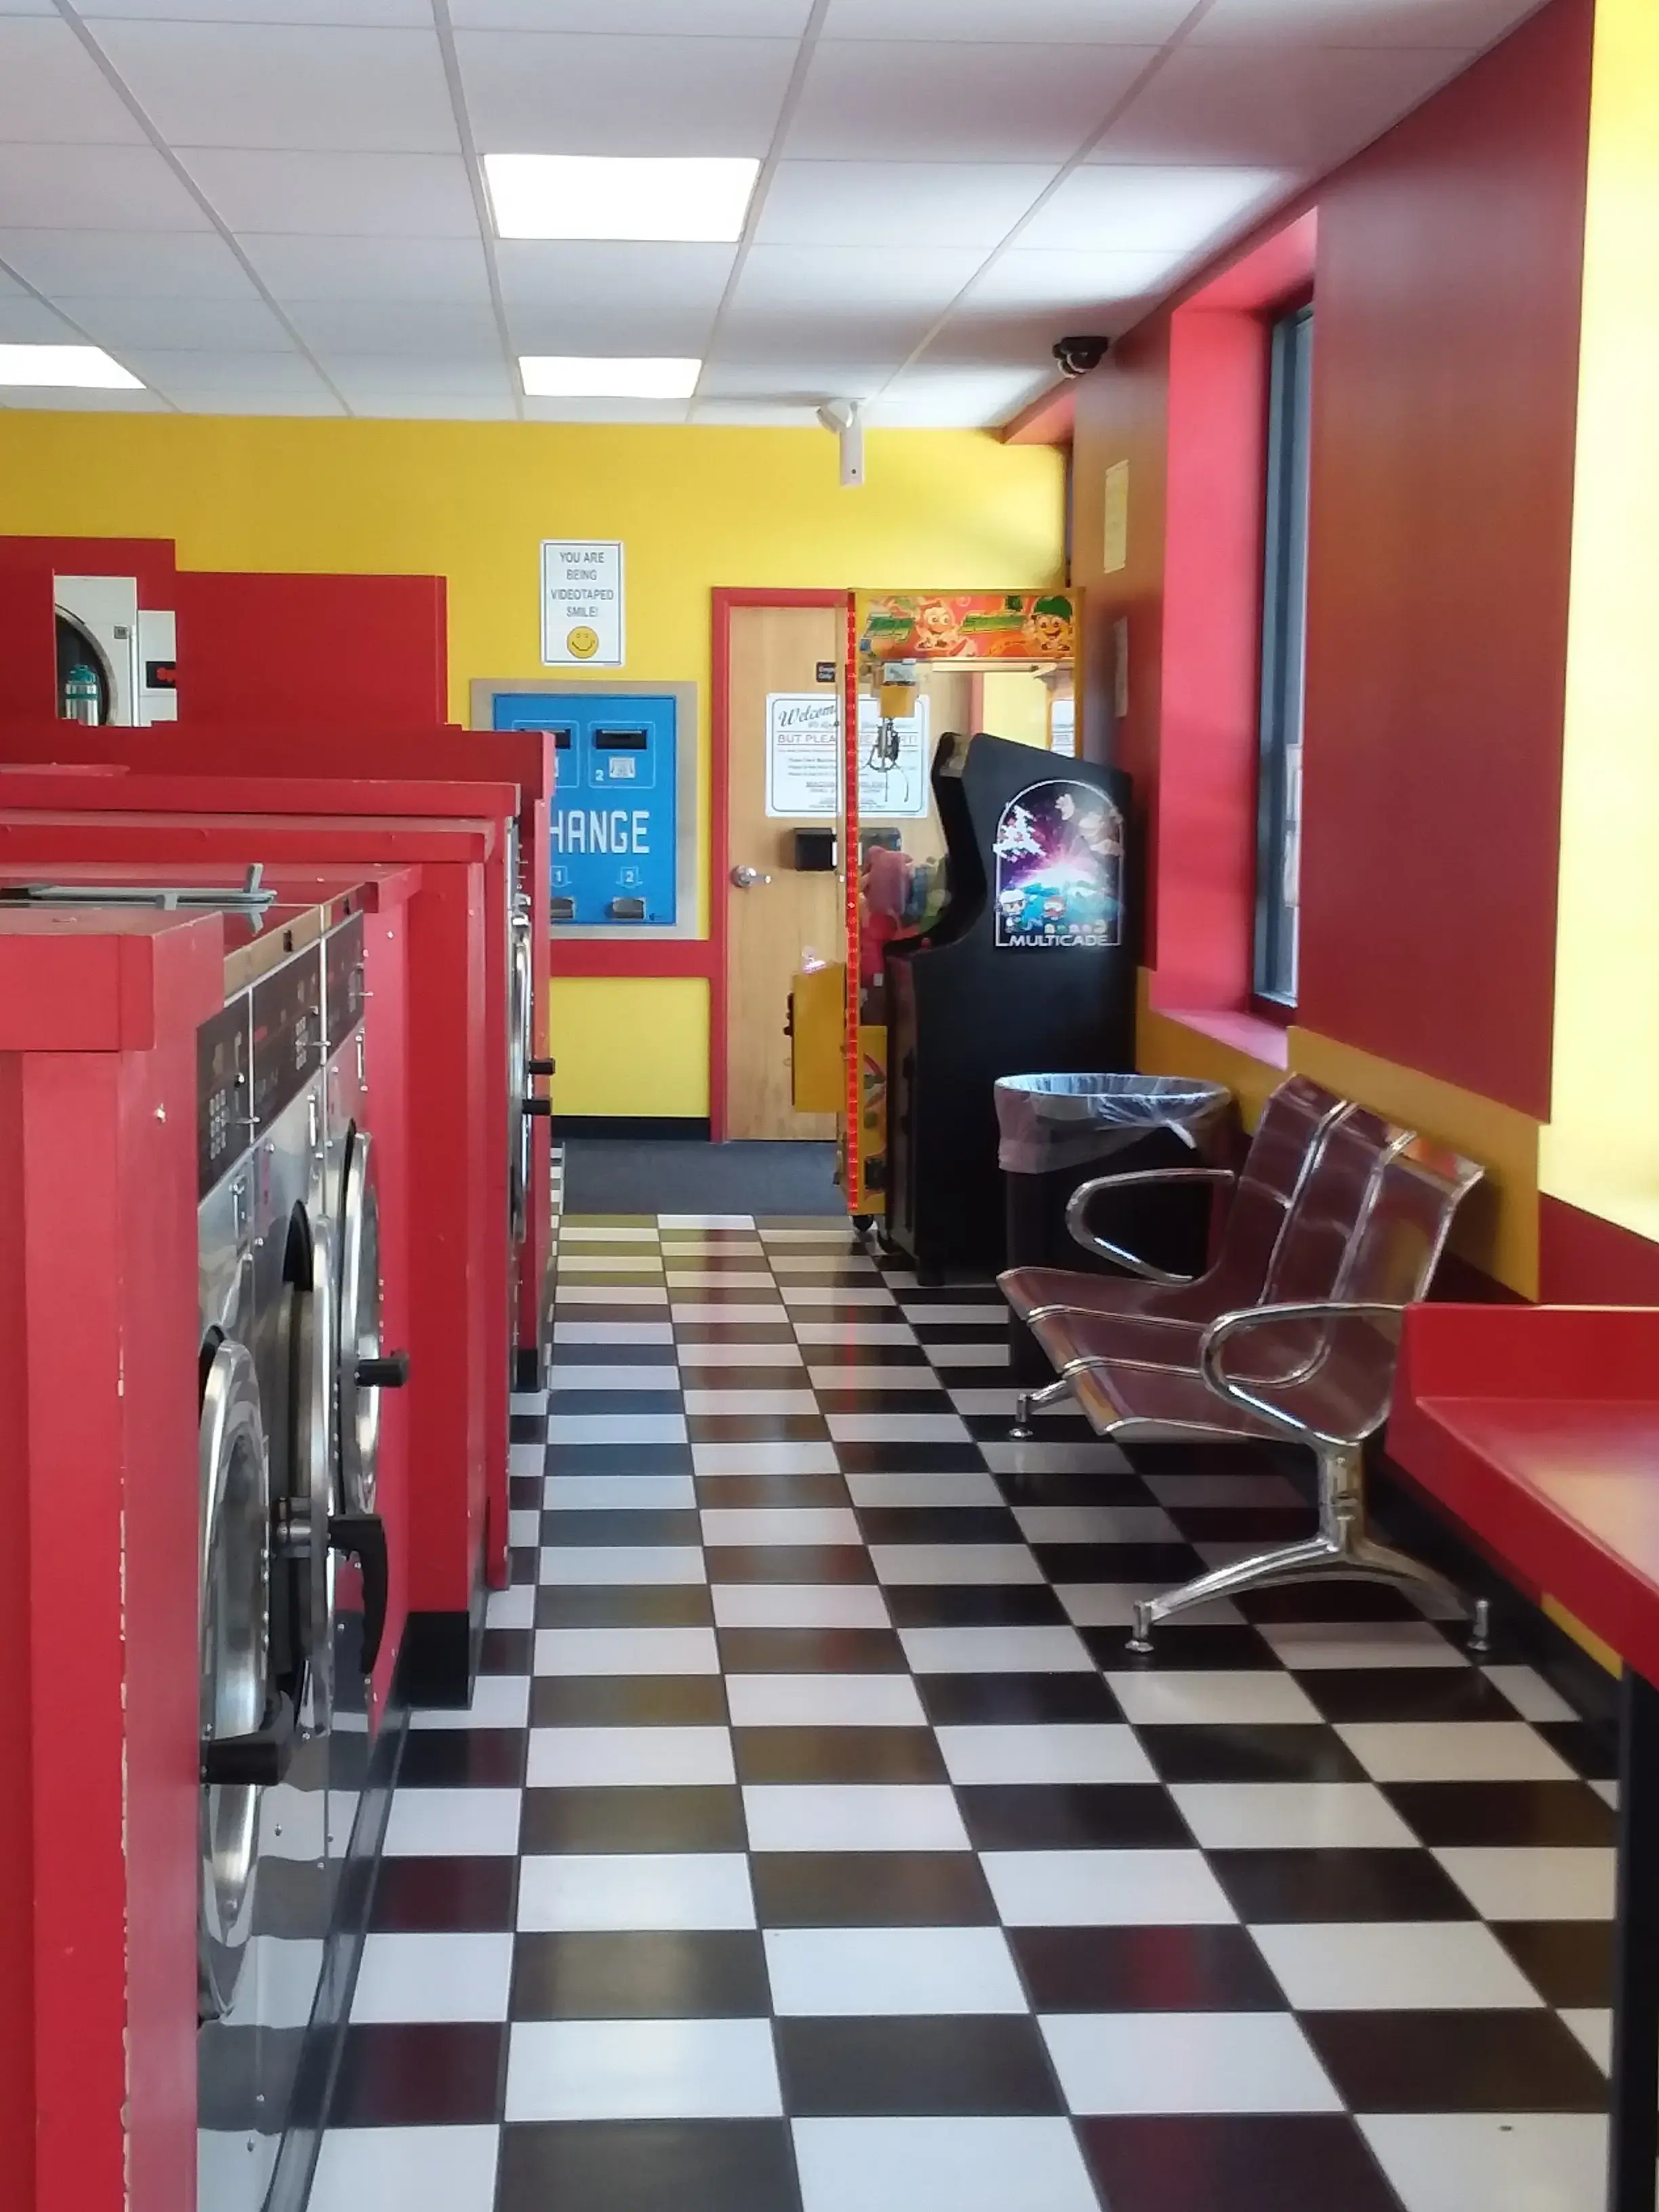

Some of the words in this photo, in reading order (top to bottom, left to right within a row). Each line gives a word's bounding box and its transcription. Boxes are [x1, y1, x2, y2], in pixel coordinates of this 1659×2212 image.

[560, 552, 580, 563] YOU
[583, 552, 604, 563] ARE
[567, 569, 596, 580] BEING
[551, 589, 613, 600] VIDEOTAPED
[567, 607, 598, 617] SMILE!
[778, 705, 835, 727] Welcom
[778, 734, 800, 743] BUT
[805, 734, 836, 743] PLEA
[595, 769, 604, 781] 2
[550, 810, 650, 854] HANGE
[555, 870, 562, 882] 1
[626, 871, 634, 882] 2
[1008, 935, 1109, 947] MULTICADE
